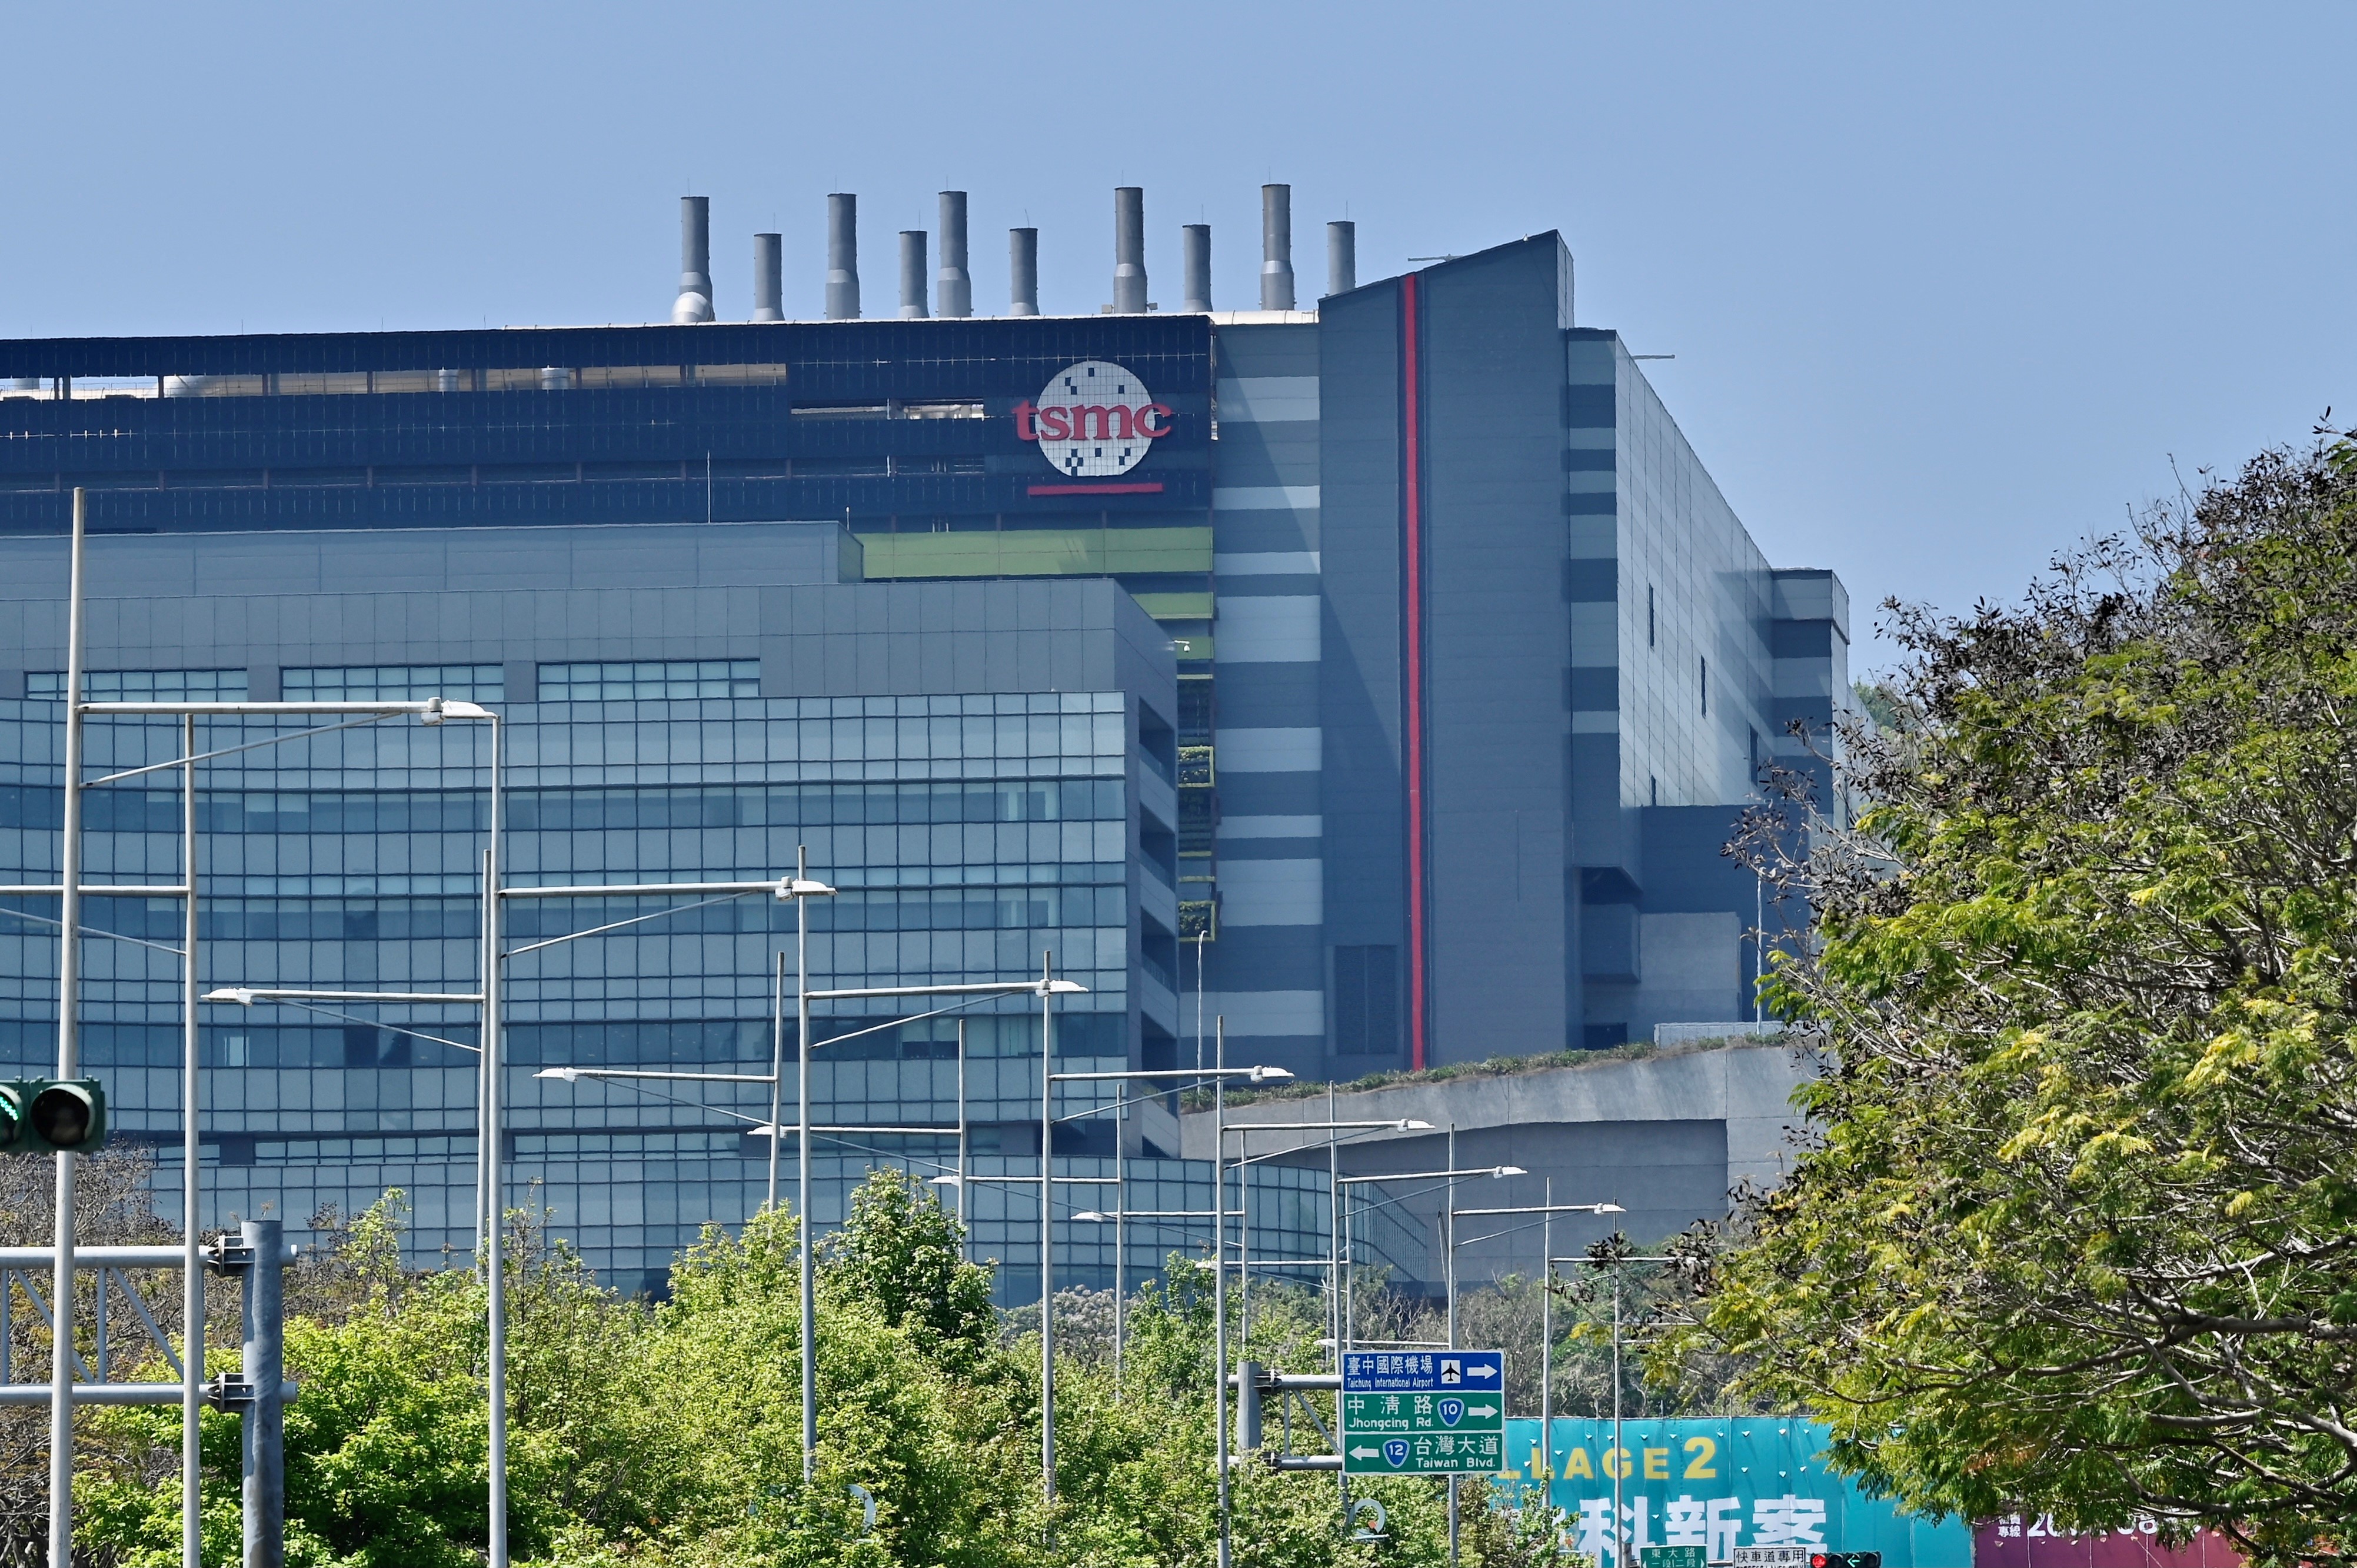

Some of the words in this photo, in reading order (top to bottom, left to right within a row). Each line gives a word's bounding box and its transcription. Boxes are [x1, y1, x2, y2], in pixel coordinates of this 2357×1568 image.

[1012, 400, 1171, 441] tsmc
[1347, 1355, 1433, 1376] 臺中國際機場
[1347, 1377, 1371, 1390] Taichung
[1375, 1377, 1410, 1388] International
[1413, 1377, 1433, 1389] Airport
[1443, 1403, 1458, 1415] 10
[1349, 1417, 1409, 1431] Jhongcing
[1416, 1417, 1434, 1427] Rd.
[1389, 1444, 1404, 1456] 12
[1413, 1435, 1499, 1456] 台灣大道
[1416, 1457, 1458, 1469] Taiwan
[1466, 1457, 1496, 1468] Blvd.
[1652, 1547, 1695, 1558] 東大路
[1736, 1550, 1804, 1563] 快車道專用
